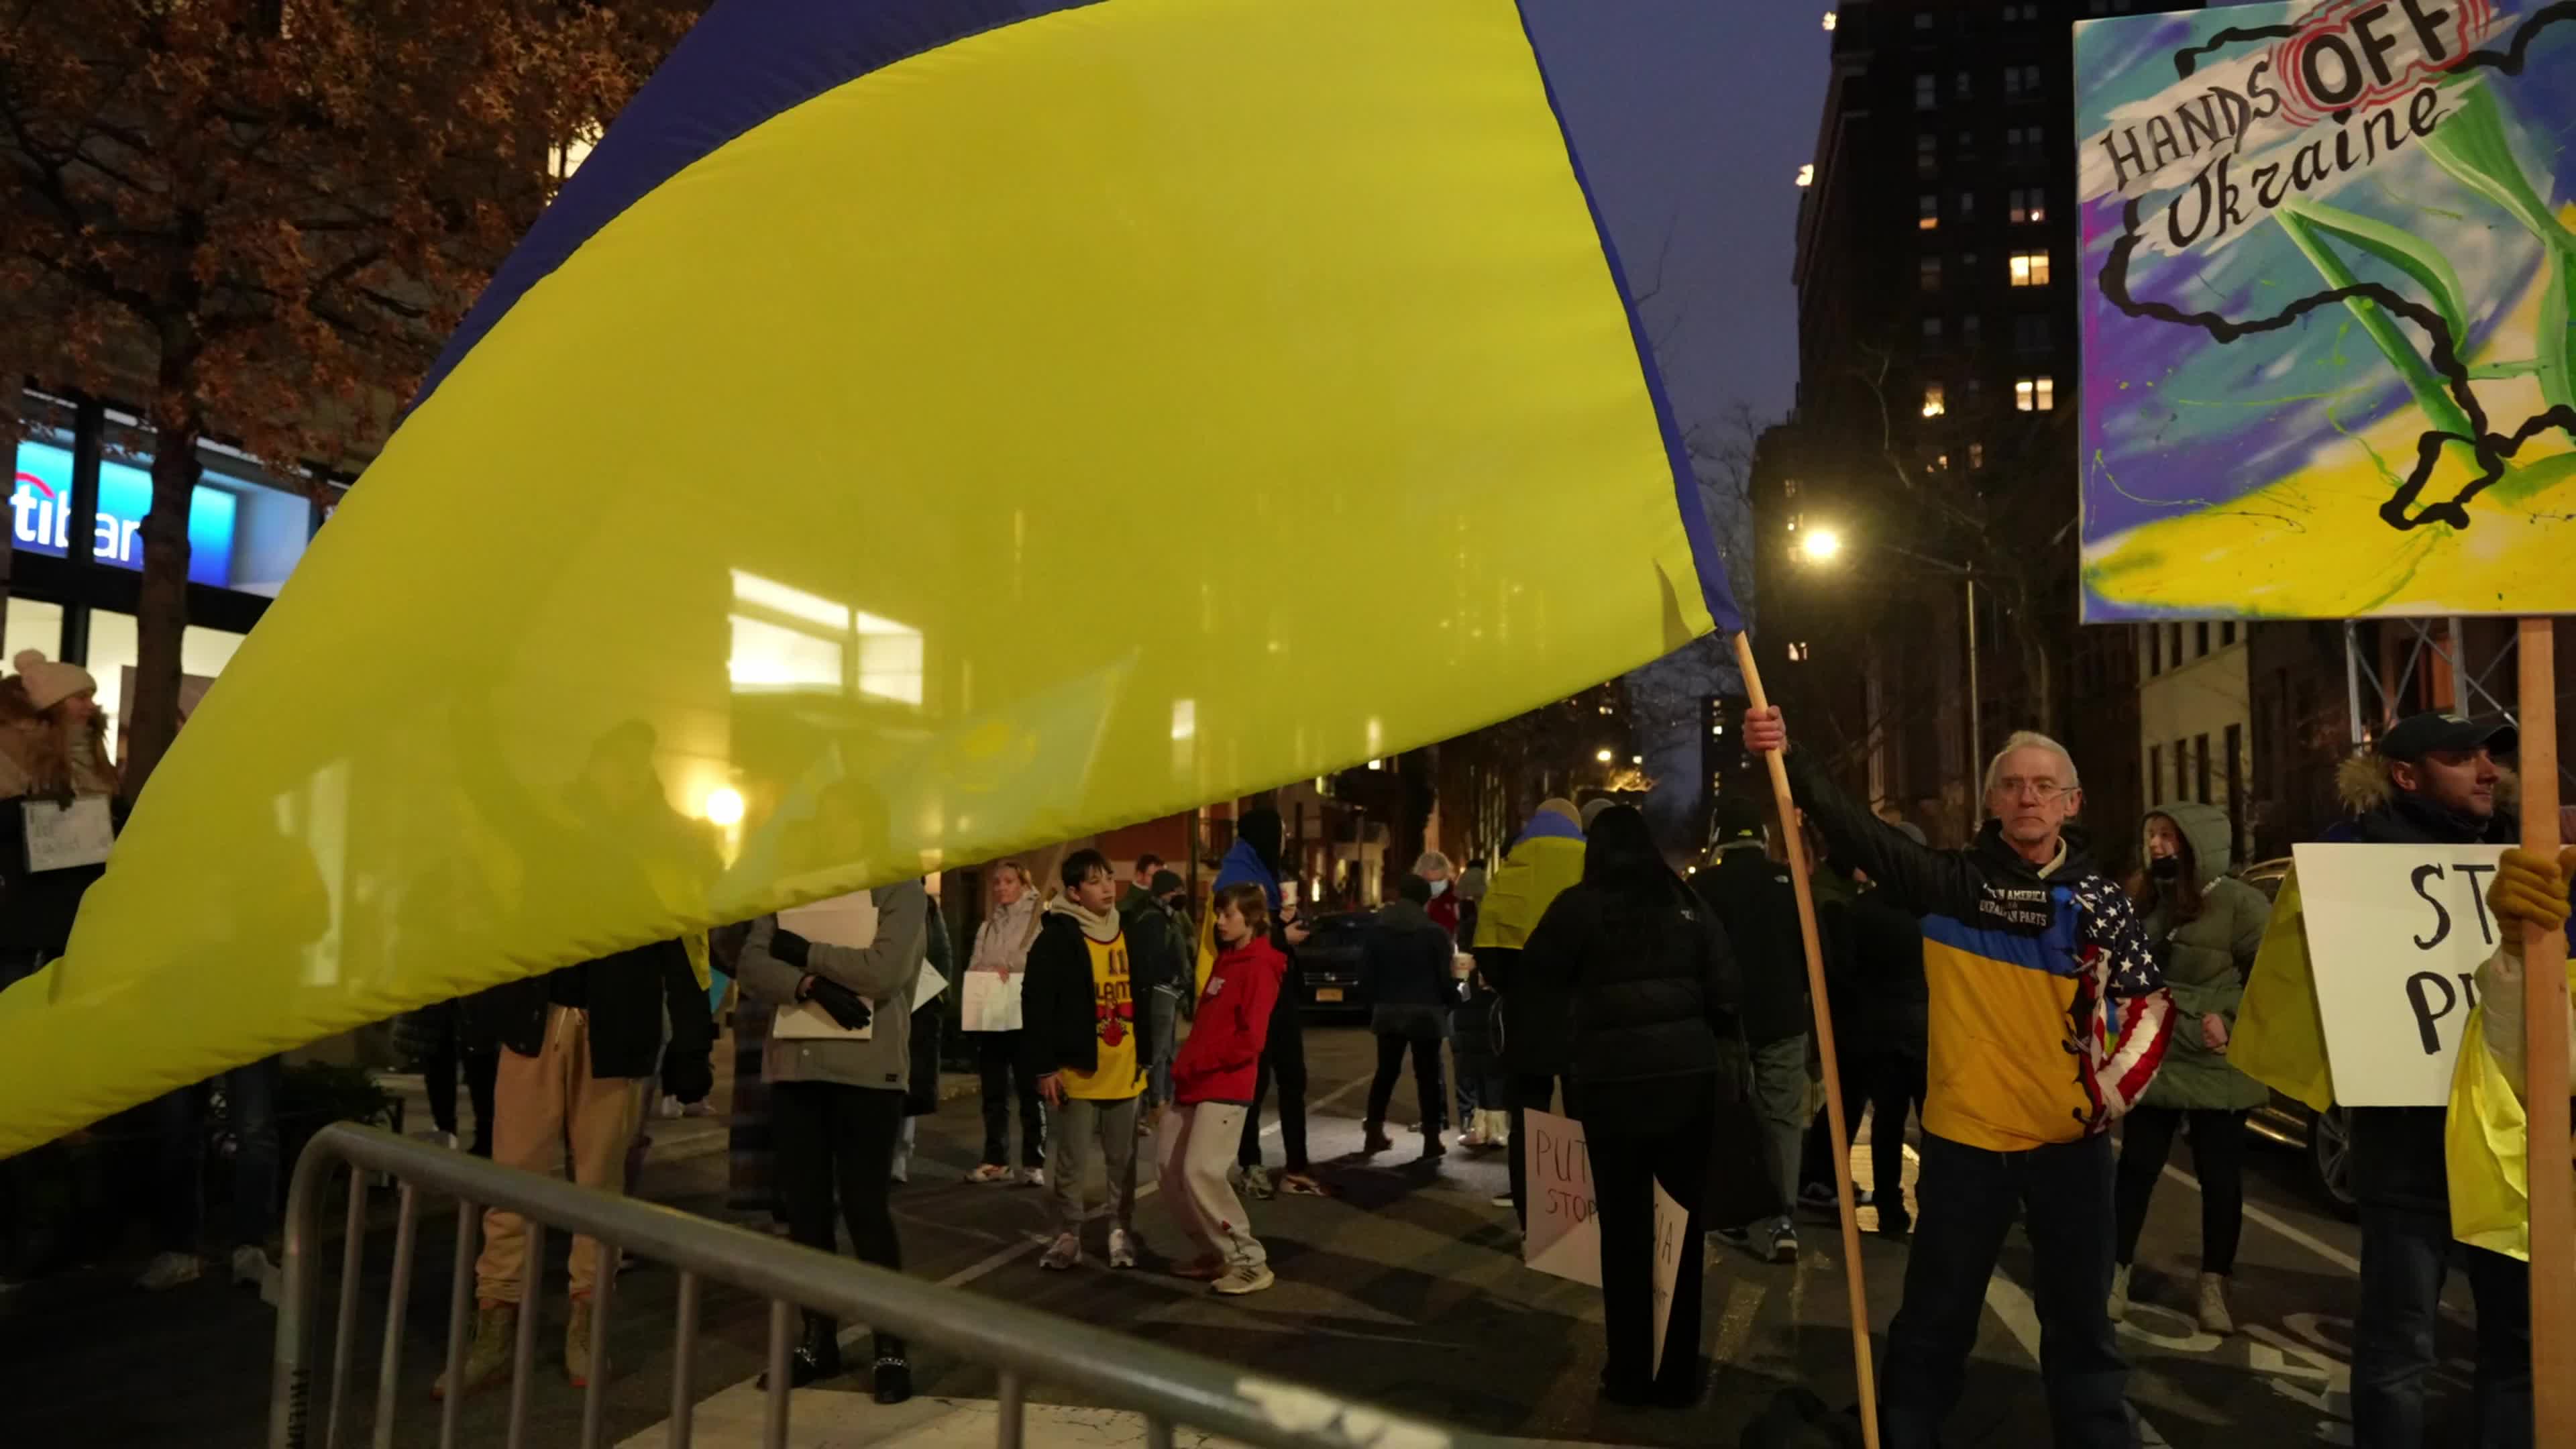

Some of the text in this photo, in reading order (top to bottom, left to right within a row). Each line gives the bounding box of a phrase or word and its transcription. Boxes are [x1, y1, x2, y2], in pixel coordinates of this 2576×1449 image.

[2099, 0, 2450, 192] HANDS OFF
[2167, 88, 2451, 248] Ukraine
[2006, 890, 2047, 902] AMERICA
[2019, 911, 2047, 926] PARTS
